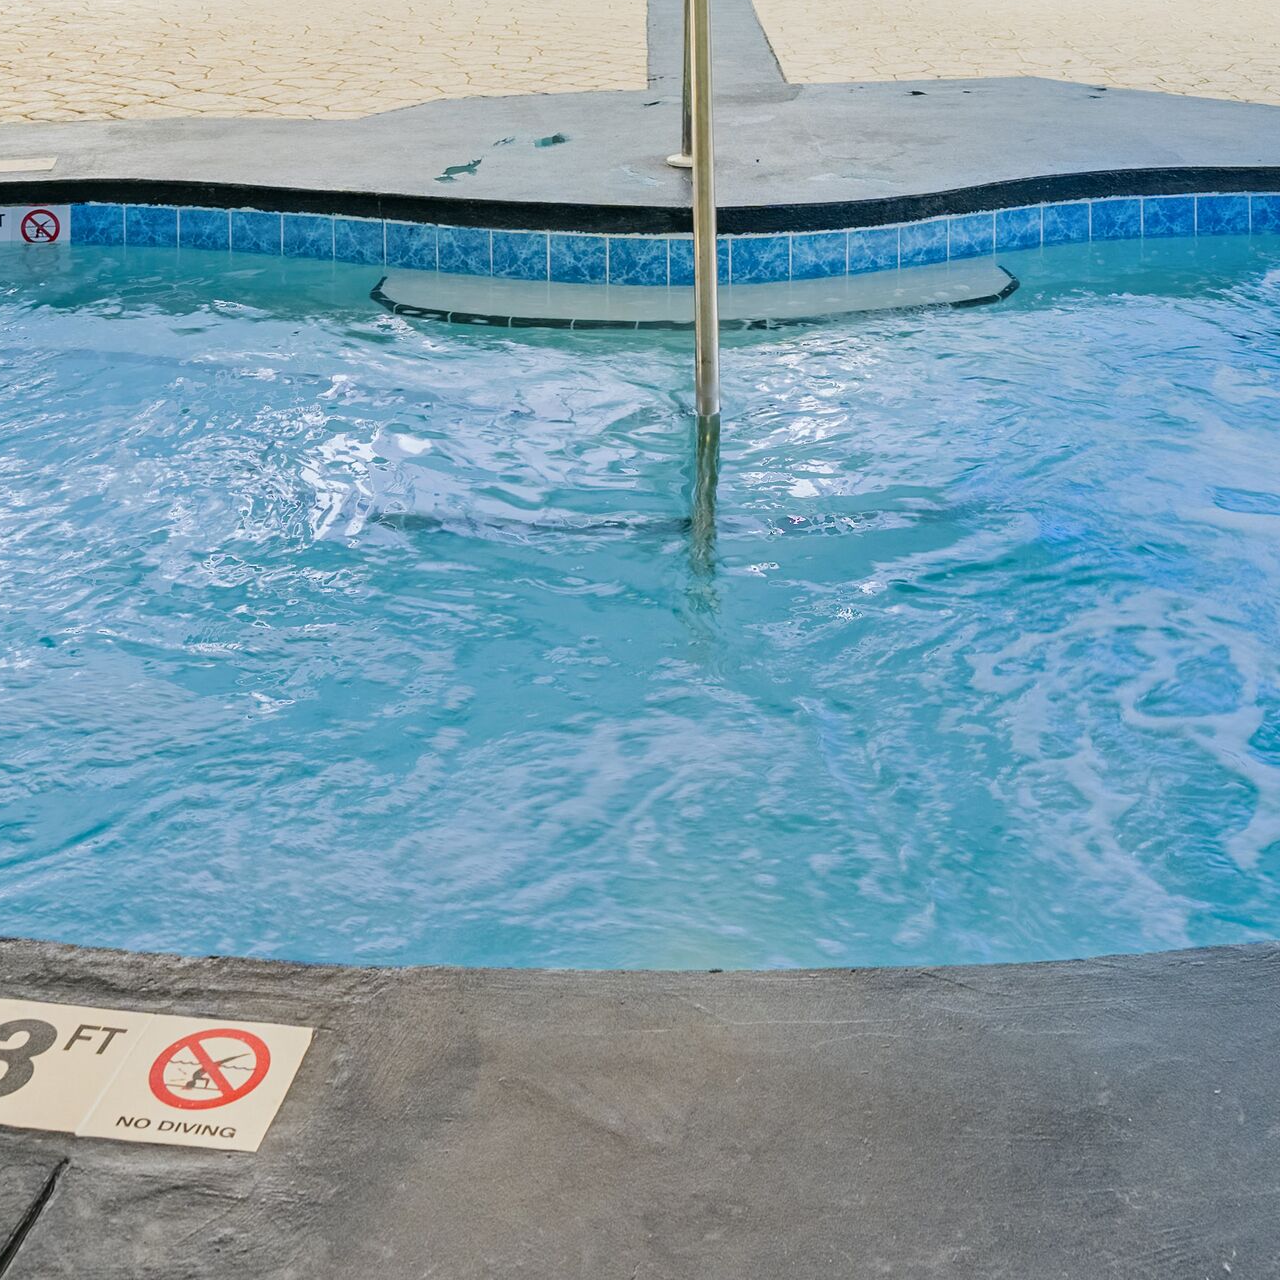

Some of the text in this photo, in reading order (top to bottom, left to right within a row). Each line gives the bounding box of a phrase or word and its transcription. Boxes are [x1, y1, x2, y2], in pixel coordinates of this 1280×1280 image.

[63, 1024, 128, 1055] FT
[115, 1116, 237, 1140] NO DIVING
